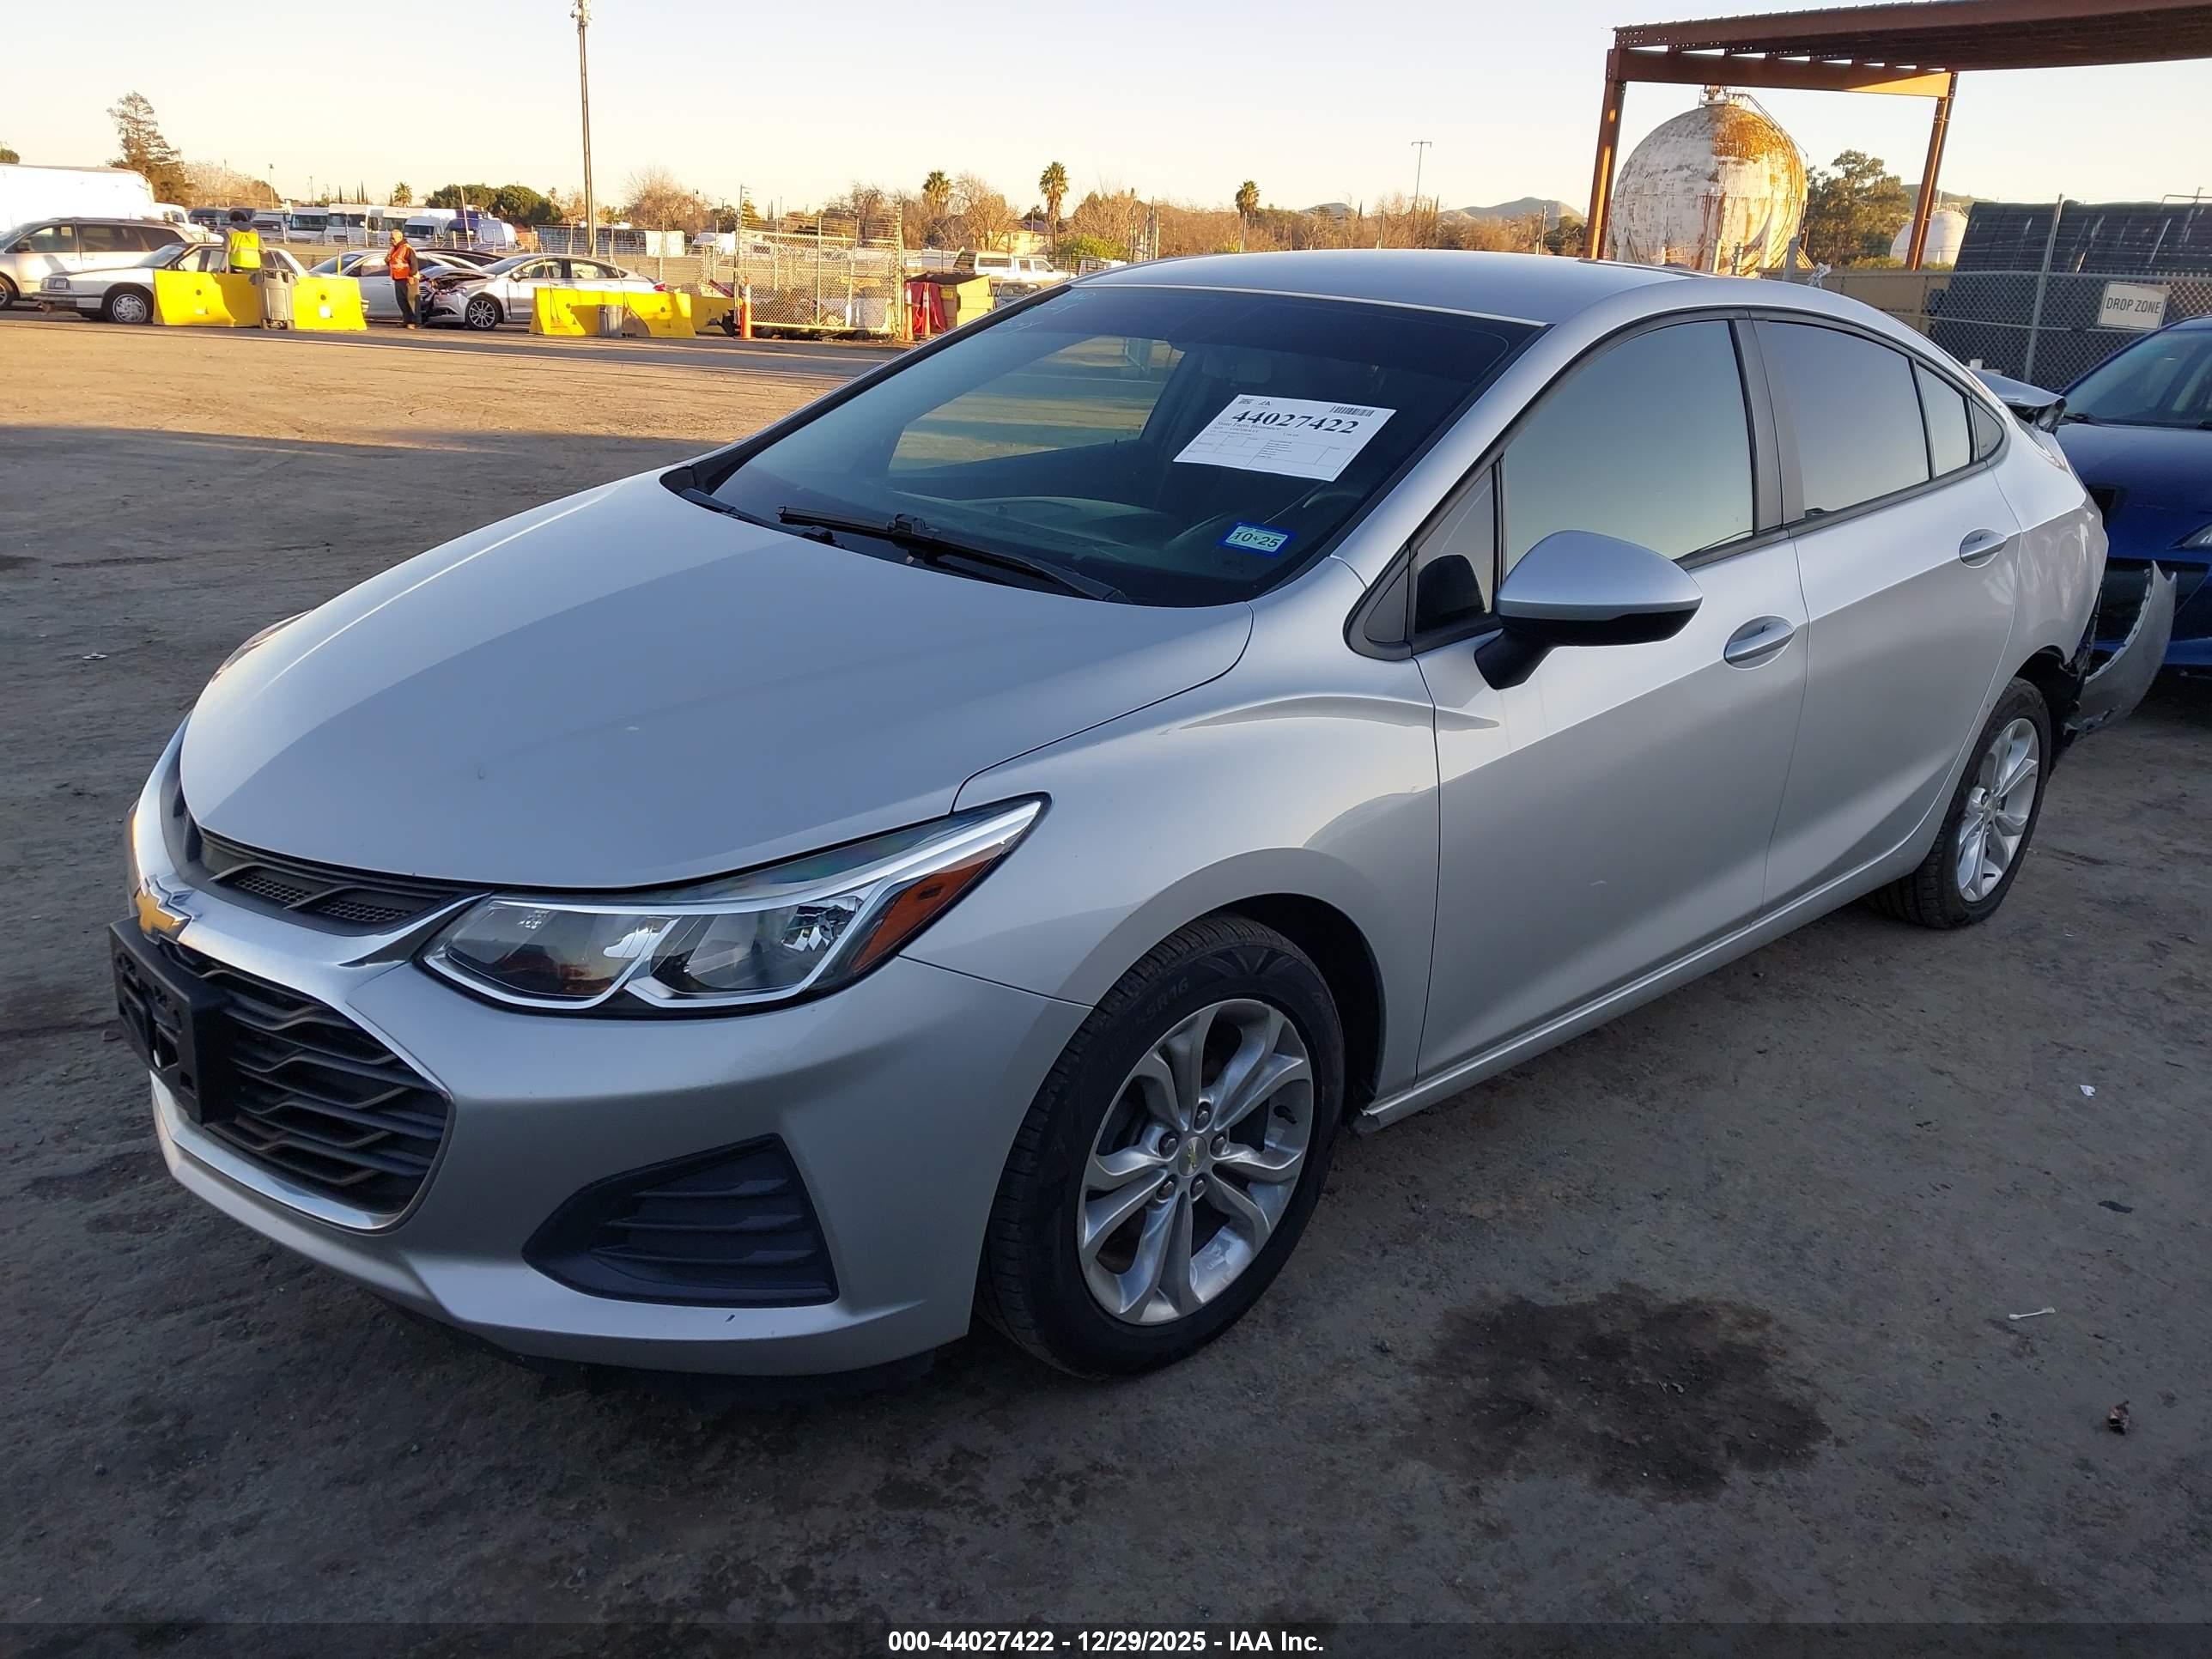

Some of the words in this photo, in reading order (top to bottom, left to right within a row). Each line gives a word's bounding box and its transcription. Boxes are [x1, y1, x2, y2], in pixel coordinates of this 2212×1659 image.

[2106, 297, 2134, 311] DROP
[2135, 300, 2161, 313] ZONE
[1231, 411, 1359, 434] 44027422
